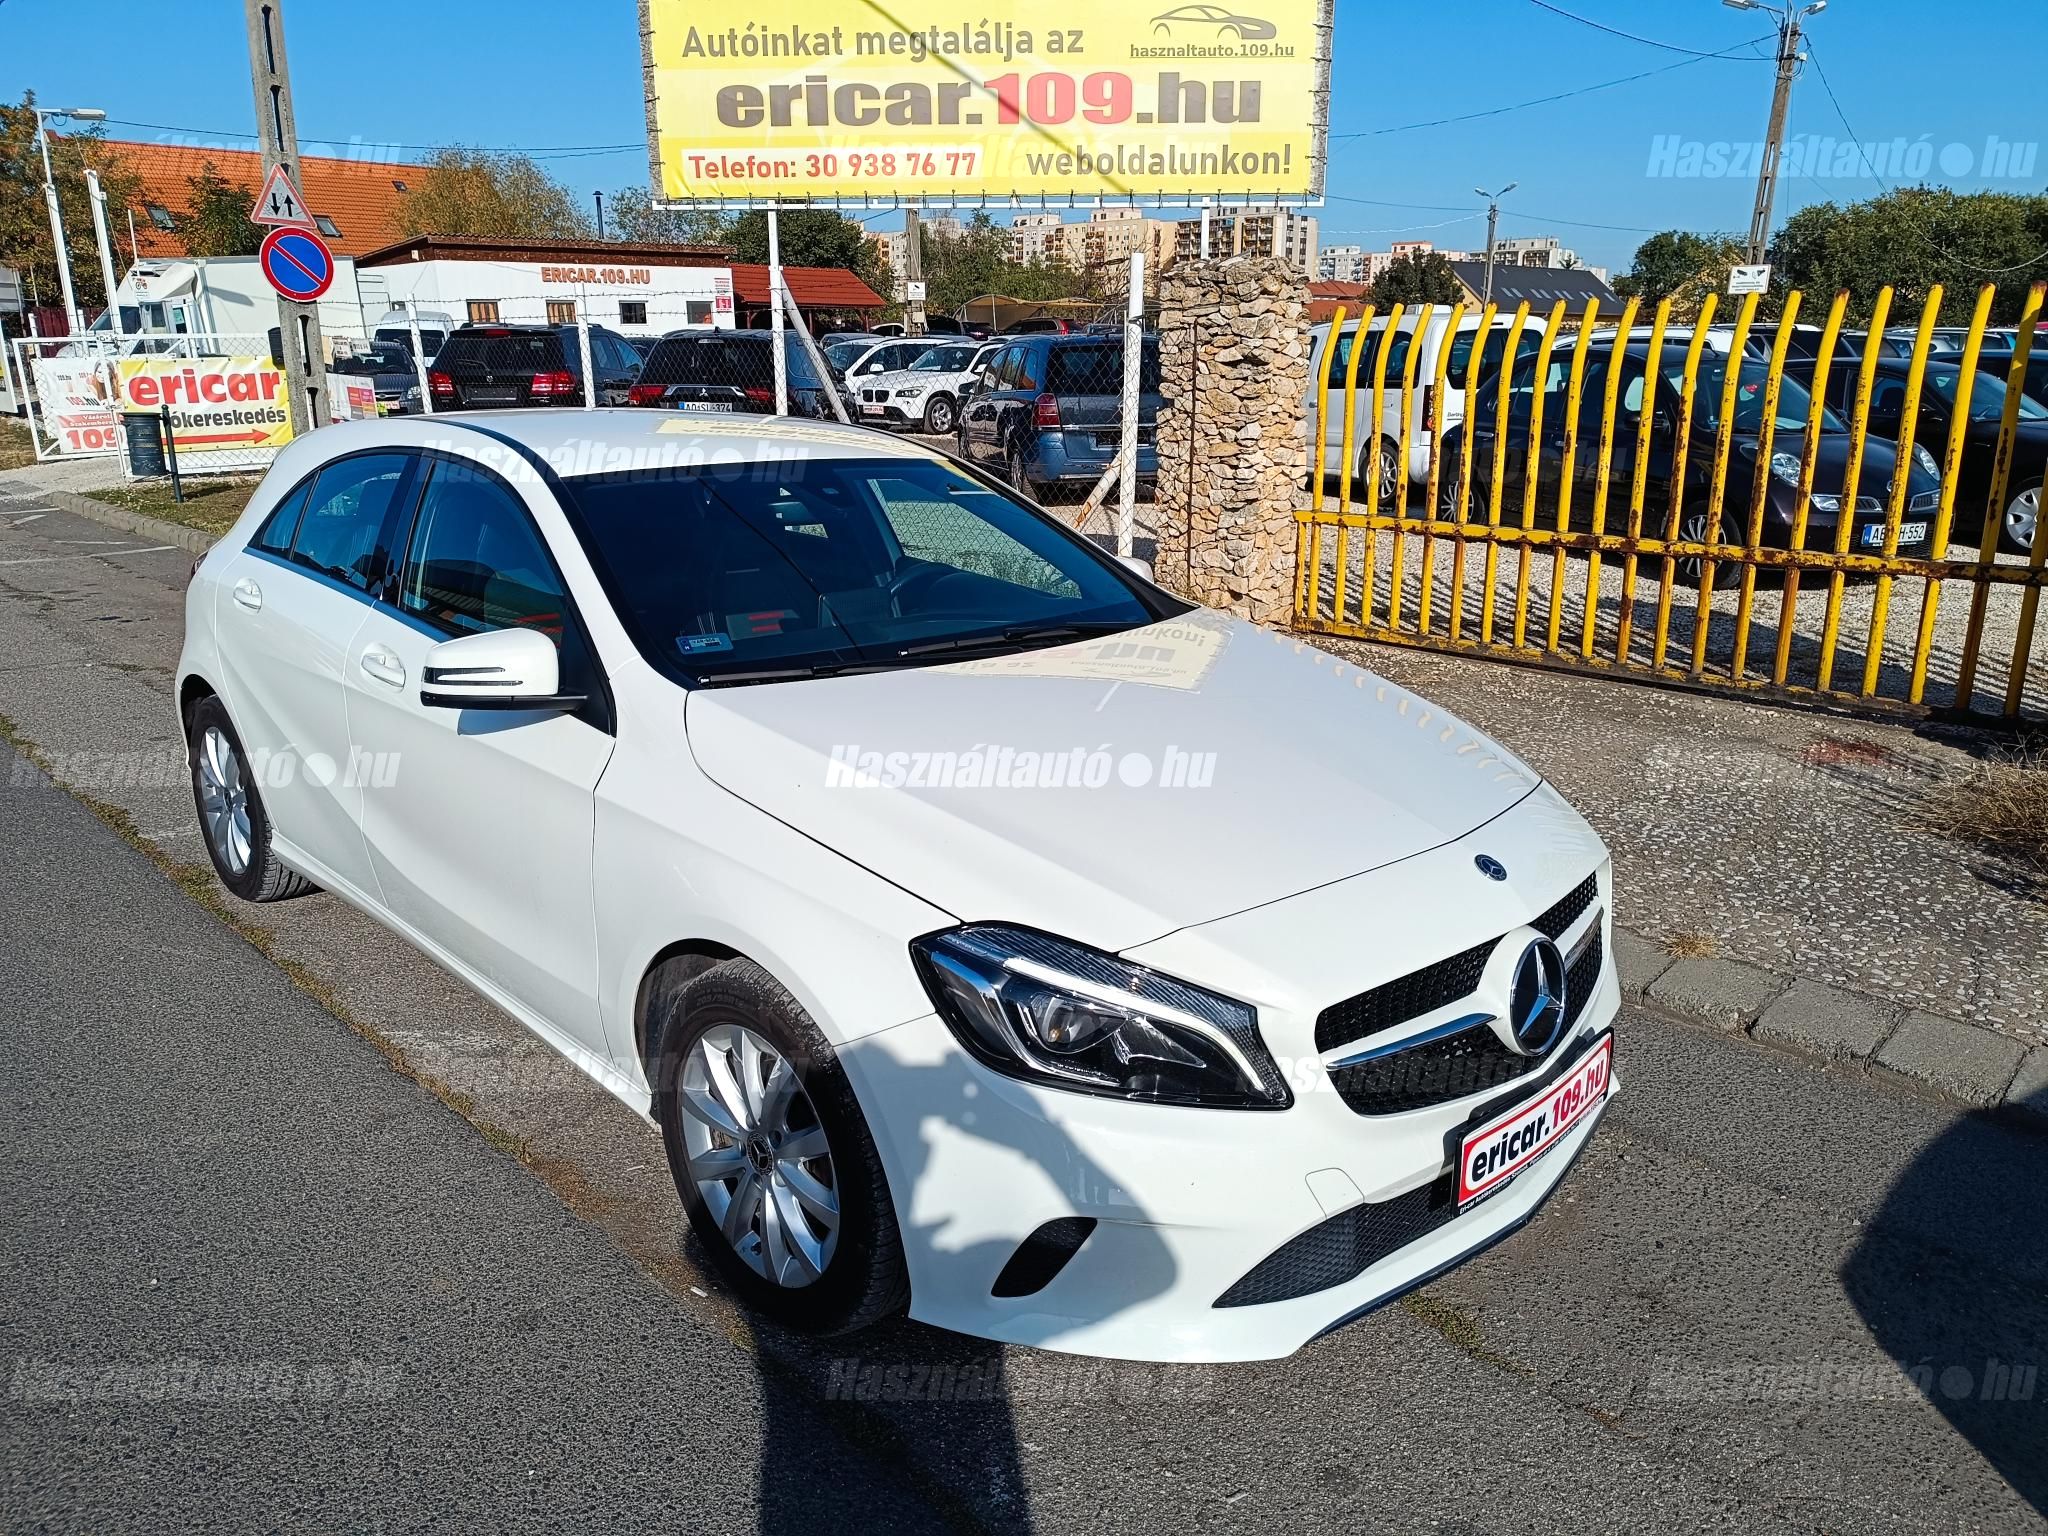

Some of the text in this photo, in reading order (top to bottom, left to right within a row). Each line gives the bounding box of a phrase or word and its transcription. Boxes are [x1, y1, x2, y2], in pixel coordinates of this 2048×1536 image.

[682, 18, 1084, 62] Autóinkat megtalálja az
[1130, 43, 1295, 57] hasznaltauto.109.hu
[716, 72, 1261, 128] ericar.109.hu
[688, 152, 976, 179] Telefon: 30 938 76 77
[1026, 144, 1292, 176] weboldalunkon!
[541, 267, 650, 284] ERICAR.109.HU
[128, 369, 281, 406] ericar
[171, 406, 287, 429] ókereskedés
